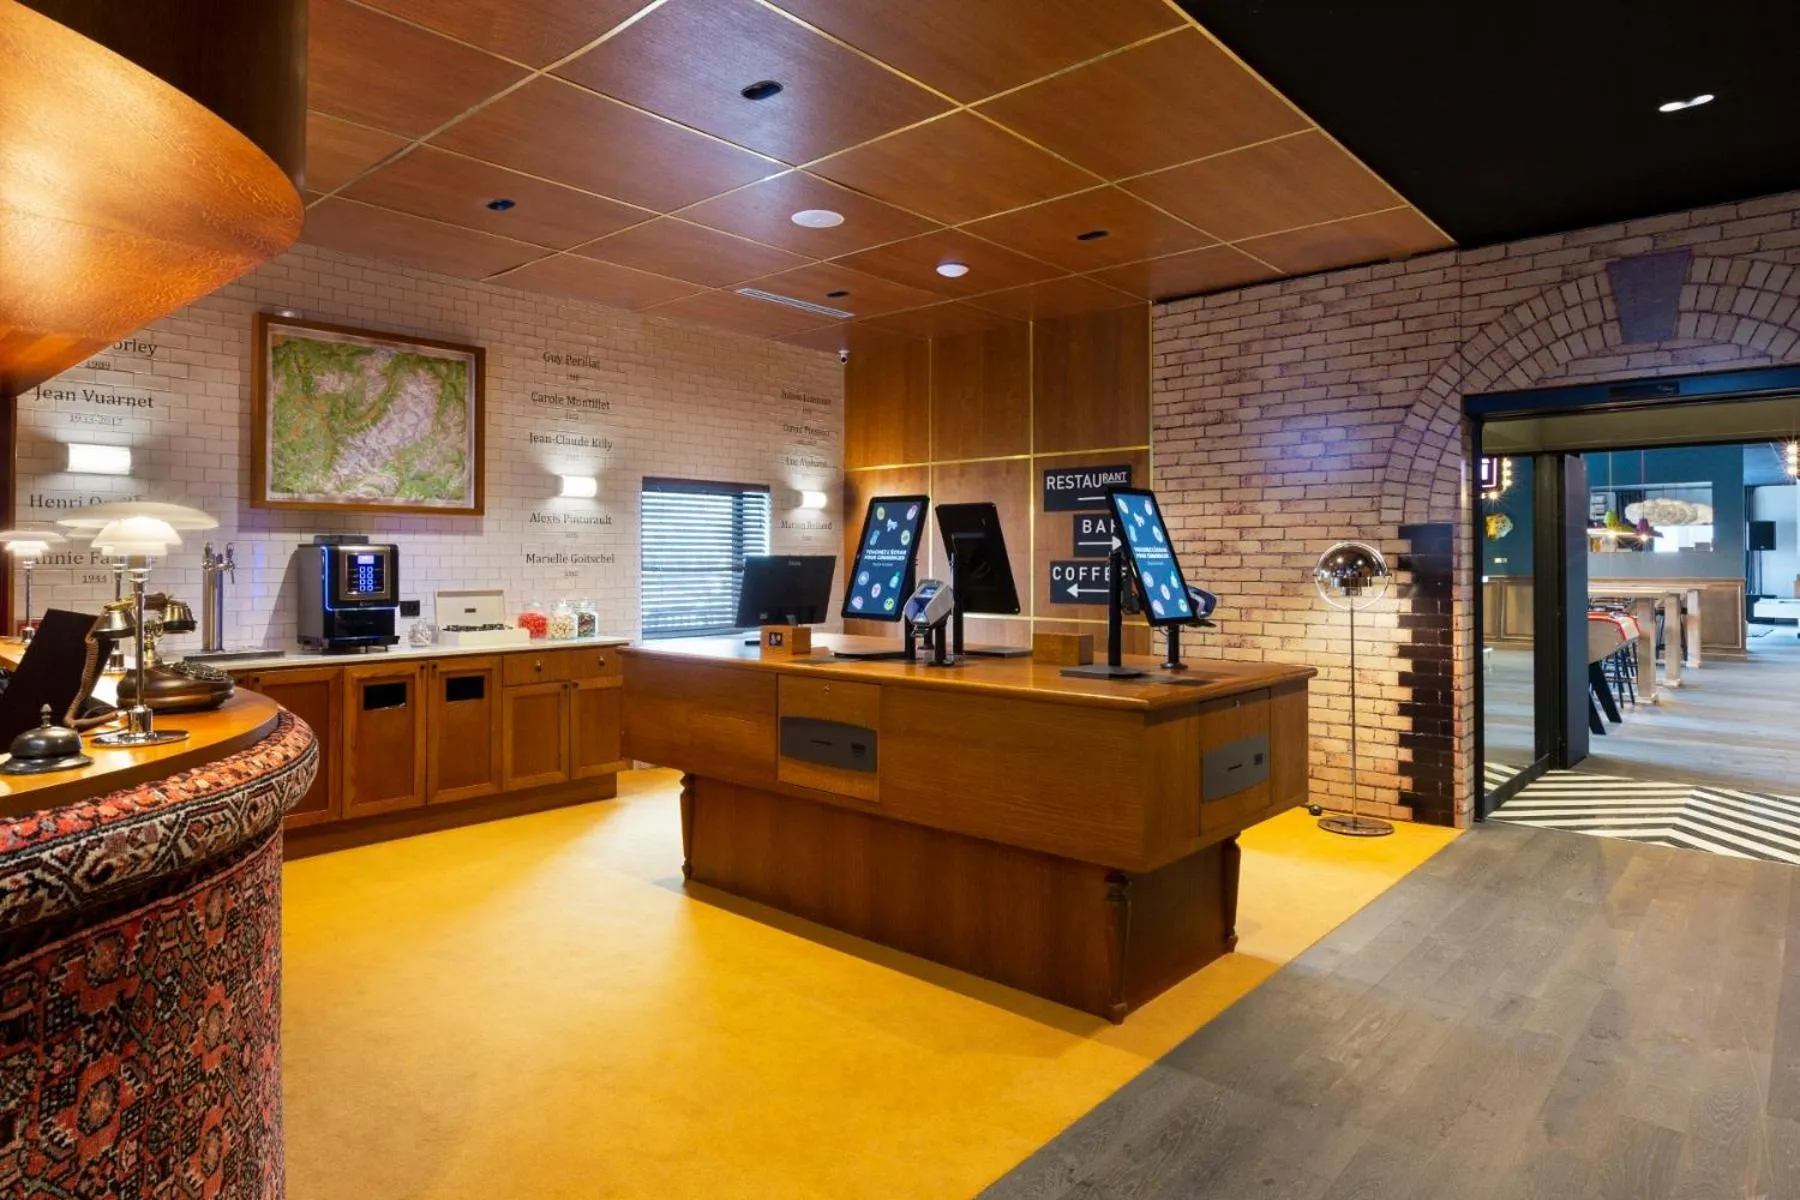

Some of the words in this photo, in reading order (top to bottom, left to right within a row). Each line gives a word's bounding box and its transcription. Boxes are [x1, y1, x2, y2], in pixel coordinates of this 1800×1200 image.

[113, 339, 158, 357] orley
[543, 352, 562, 365] Guy
[35, 385, 76, 401] Jean
[82, 389, 154, 408] Vuarnet
[531, 391, 565, 406] Carole
[529, 432, 590, 447] Jean-Claude
[592, 436, 613, 451] Killy
[1046, 471, 1127, 490] RESTAURANT
[30, 493, 82, 509] Henri
[526, 553, 568, 564] Marielle
